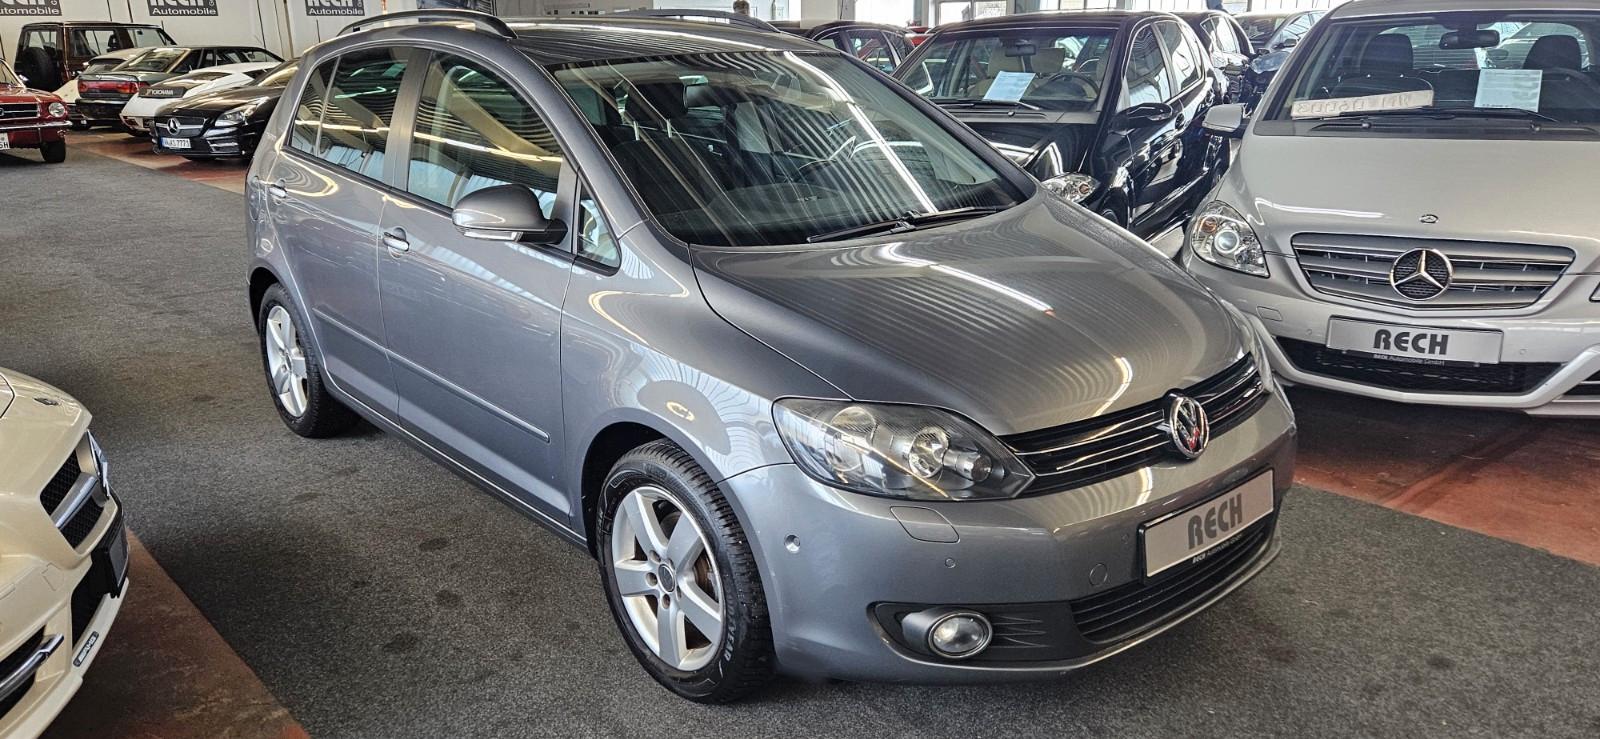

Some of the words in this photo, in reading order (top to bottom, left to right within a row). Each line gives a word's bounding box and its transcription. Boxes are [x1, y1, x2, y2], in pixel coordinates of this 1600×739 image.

[152, 7, 217, 15] Automobile
[1373, 329, 1449, 355] RECH
[1188, 492, 1243, 550] RECH
